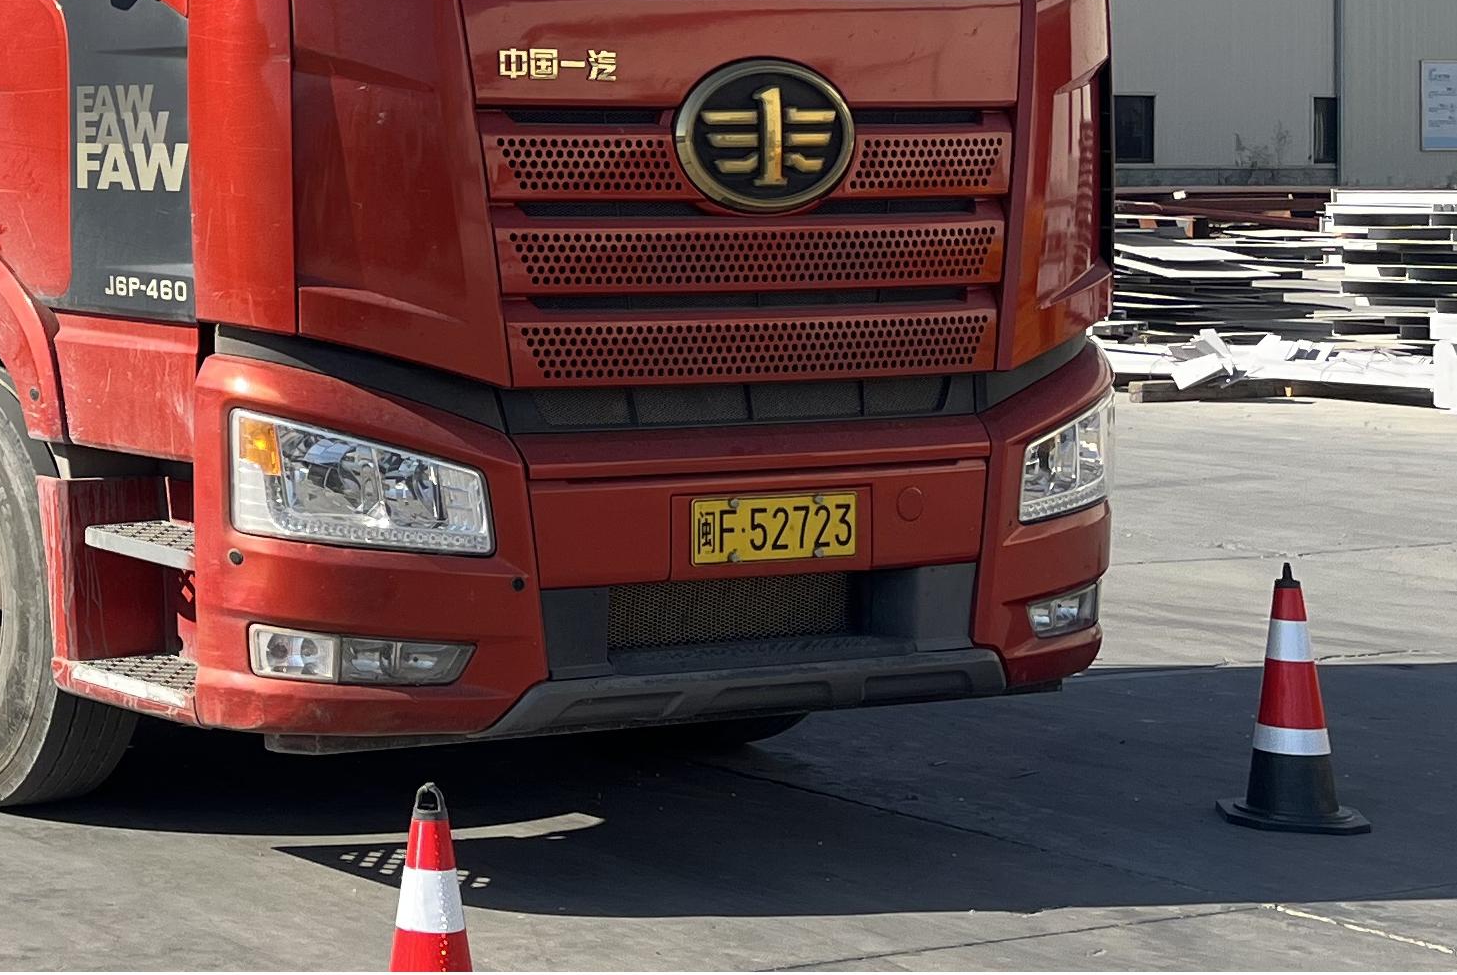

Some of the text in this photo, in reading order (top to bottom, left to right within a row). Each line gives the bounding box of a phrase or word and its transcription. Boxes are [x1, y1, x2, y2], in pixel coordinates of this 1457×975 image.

[498, 47, 617, 81] 中国一汽
[76, 83, 155, 115] FAW
[76, 110, 170, 147] FAW
[76, 142, 189, 192] FAW
[104, 275, 188, 302] J6P-460
